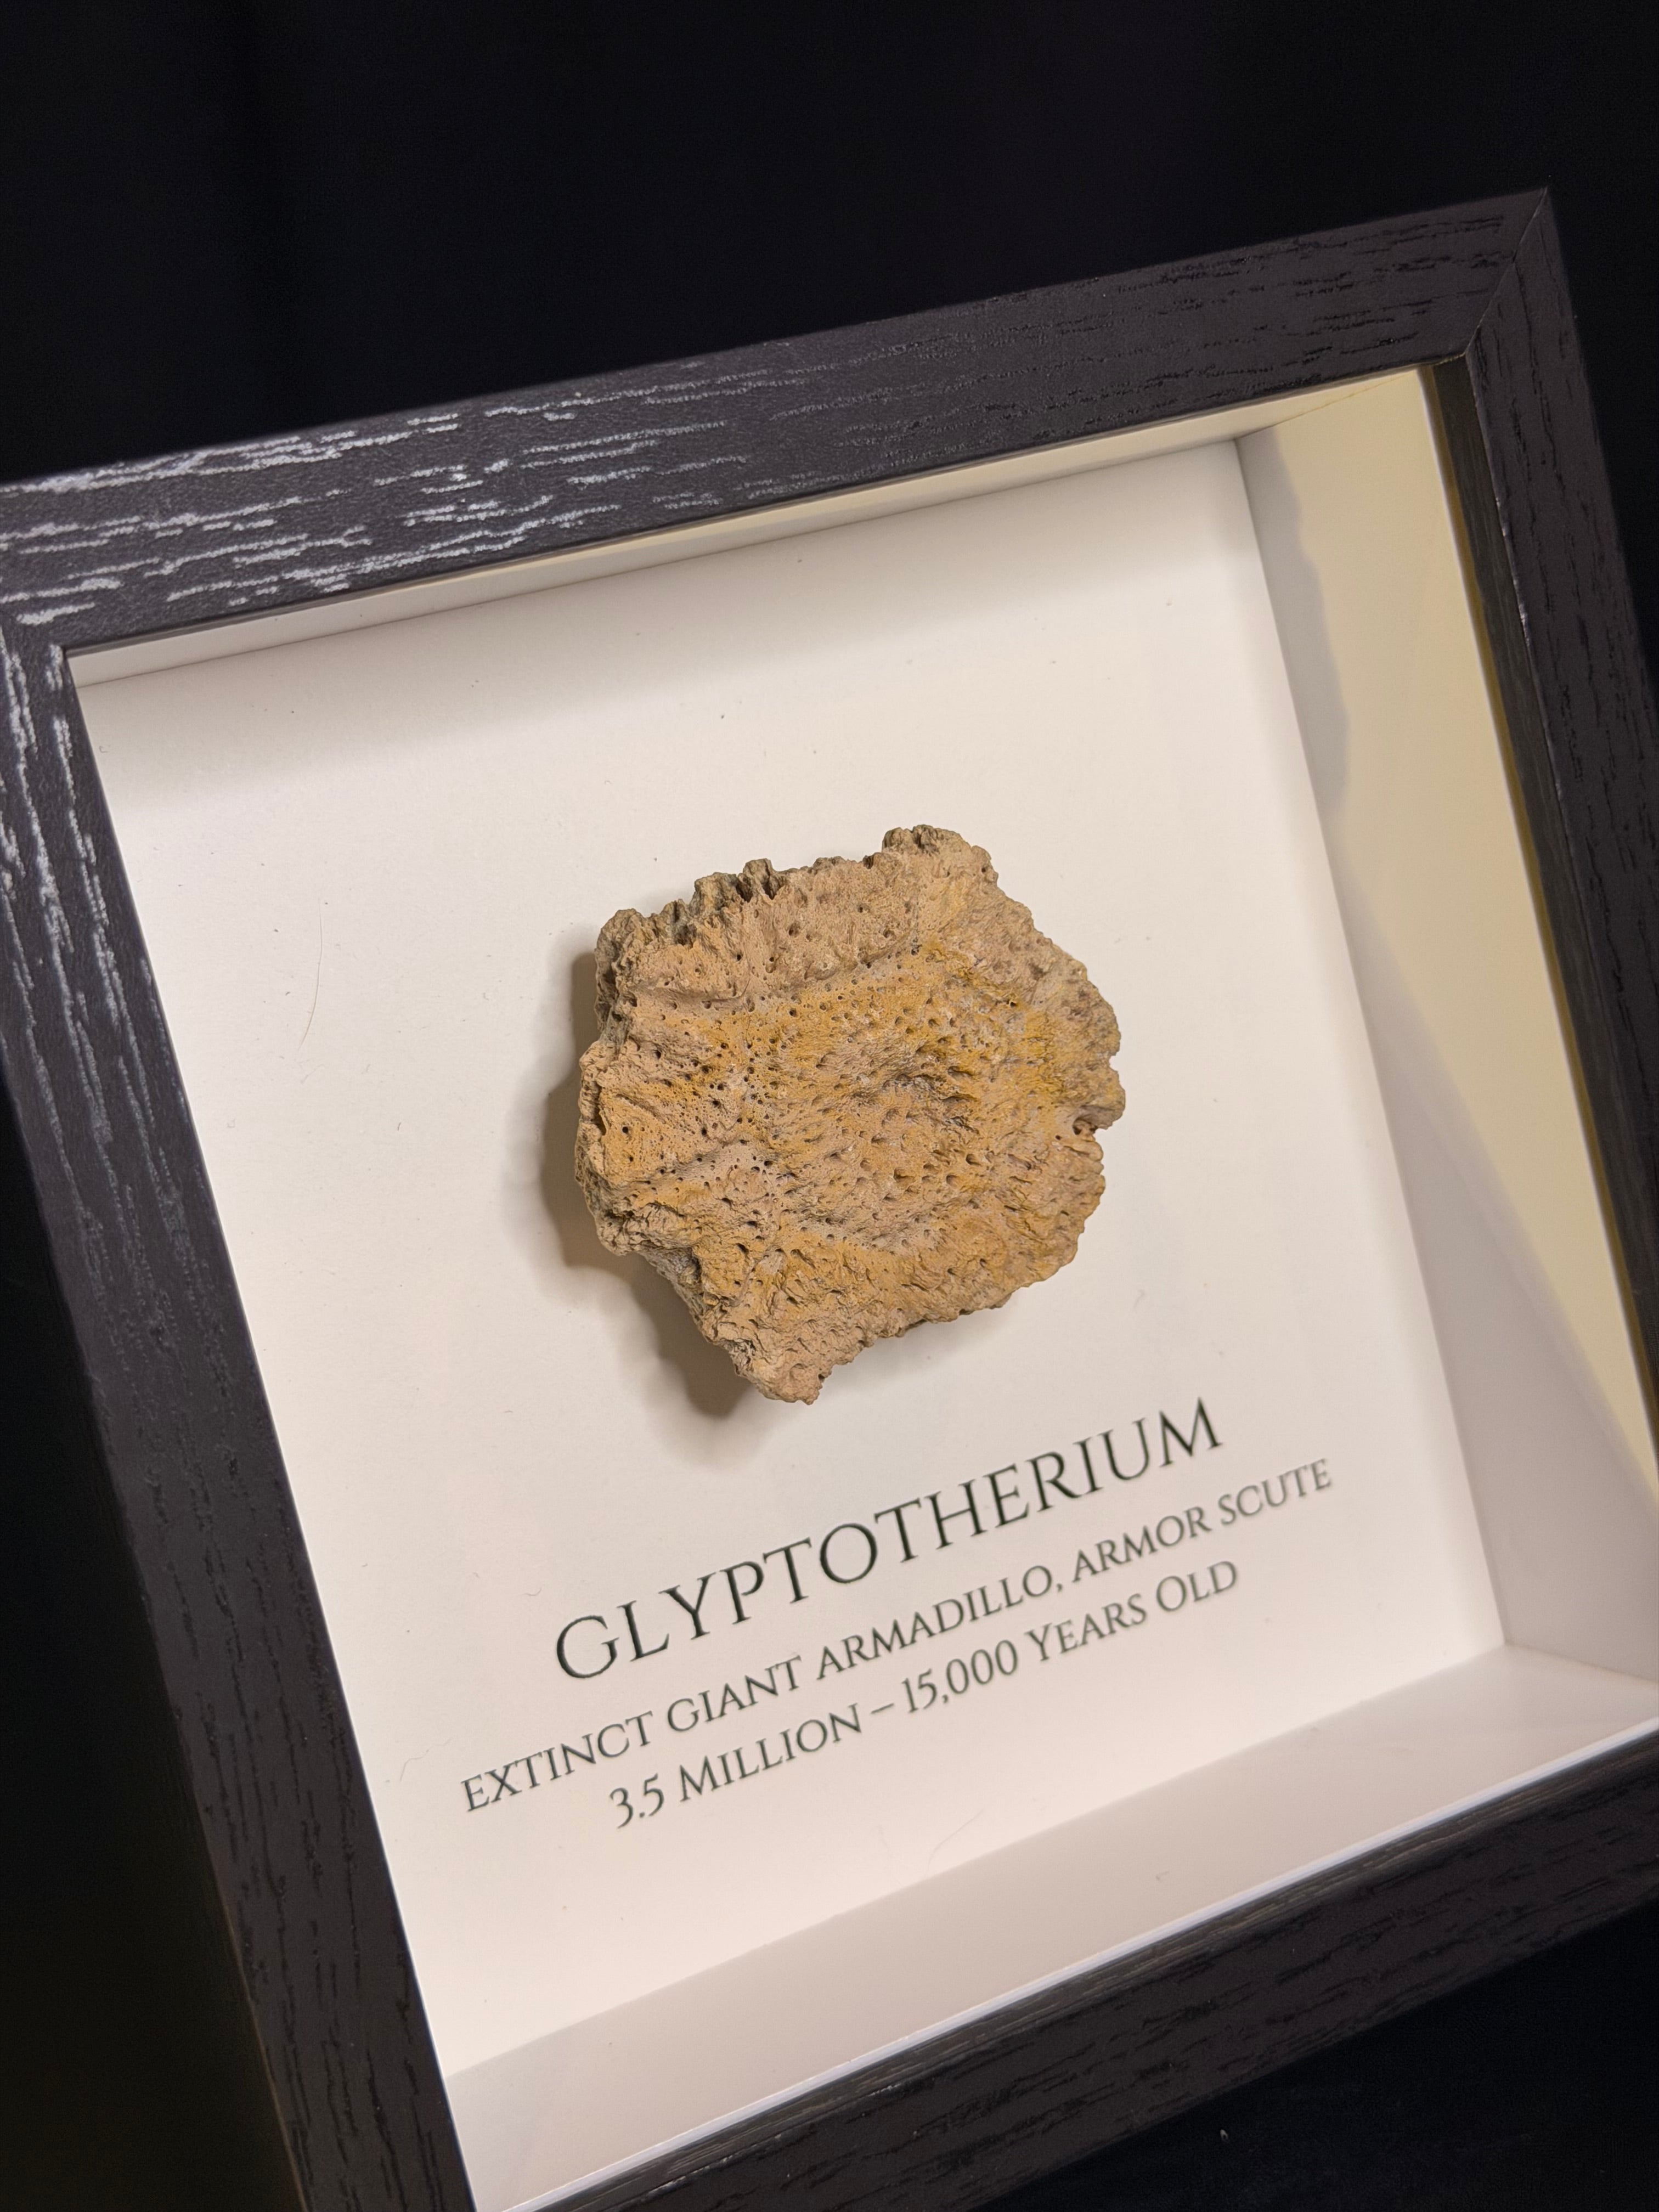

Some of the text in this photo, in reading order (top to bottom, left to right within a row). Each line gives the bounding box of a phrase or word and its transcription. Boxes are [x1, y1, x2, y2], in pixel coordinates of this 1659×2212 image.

[461, 1459, 1331, 1812] EXTINCT GIANT ARMADILLO, ARMOR SCUTE
[556, 1397, 1223, 1679] GLYPTOTHERIUM
[610, 1773, 664, 1829] 3.5
[680, 1703, 861, 1802] MILLION
[901, 1640, 1018, 1713] 15,000
[1025, 1594, 1147, 1662] YEARS
[1156, 1561, 1238, 1612] OLD
